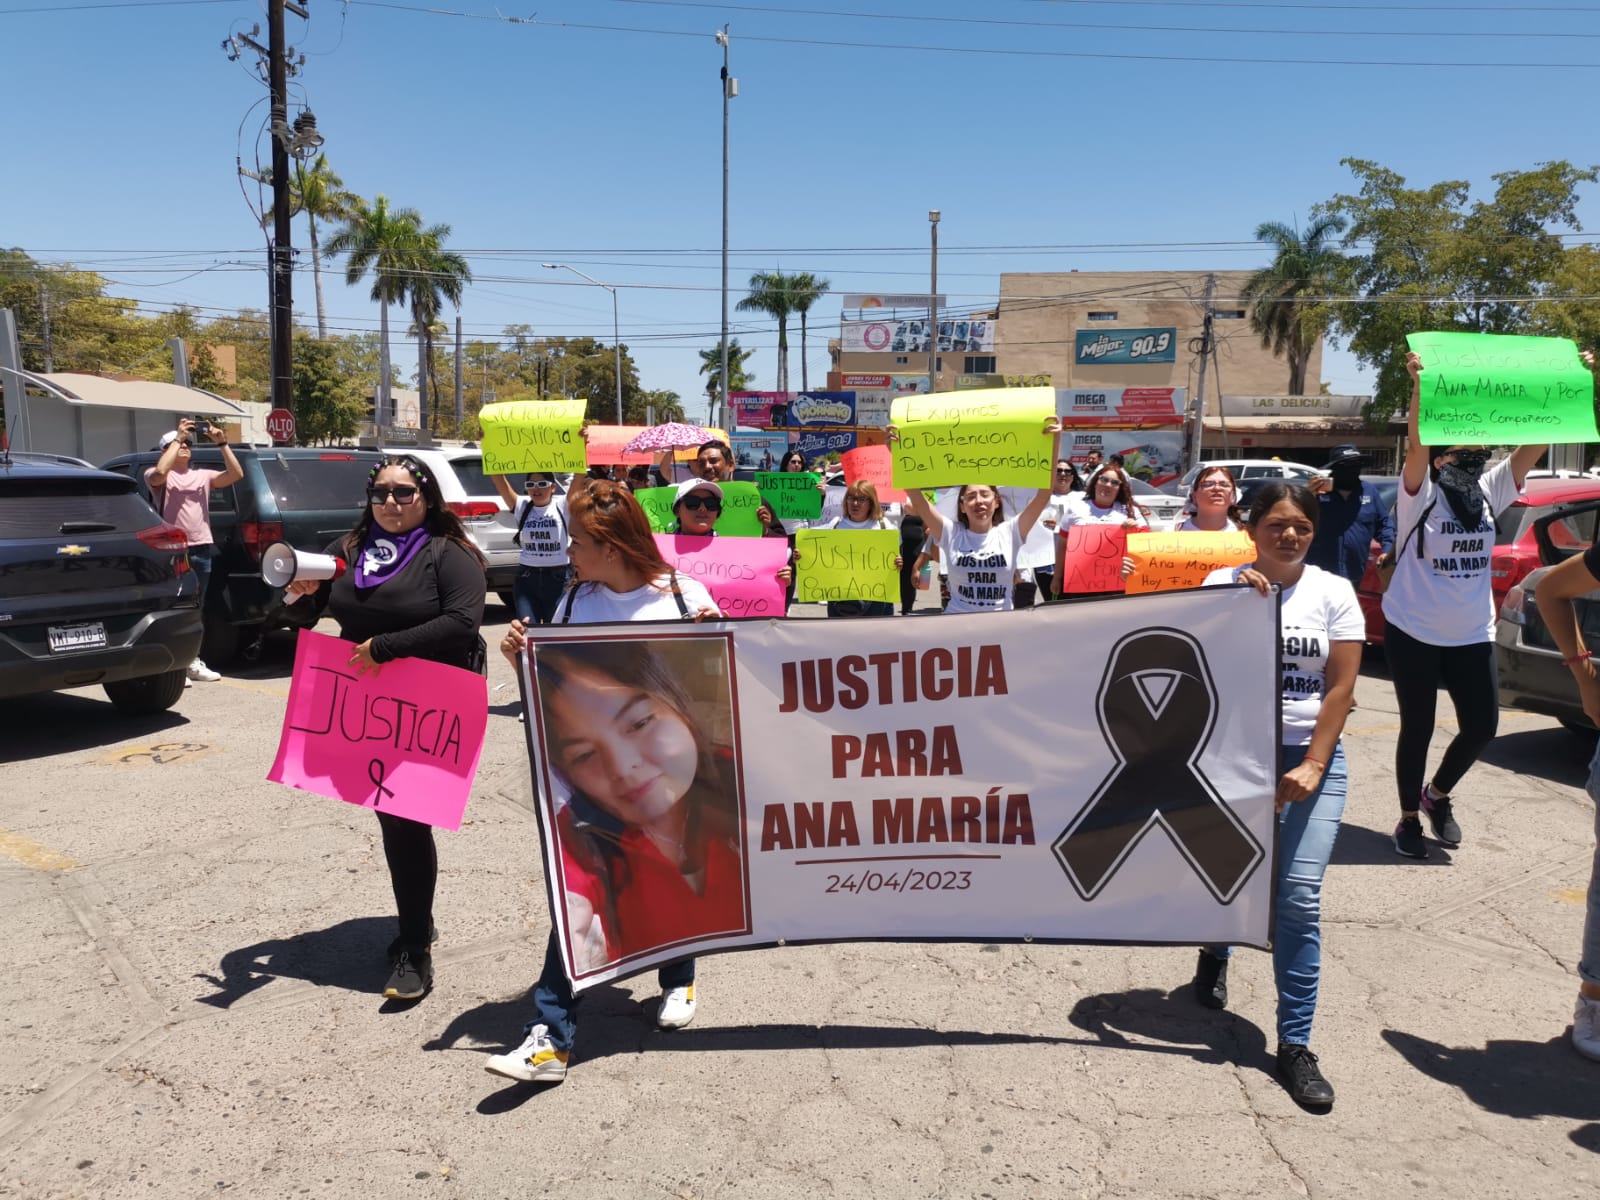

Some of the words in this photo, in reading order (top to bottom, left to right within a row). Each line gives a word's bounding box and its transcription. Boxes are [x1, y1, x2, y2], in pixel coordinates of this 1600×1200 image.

[1080, 340, 1124, 358] Mejor
[1130, 332, 1170, 358] 90.9
[1075, 393, 1106, 405] MEGA
[1252, 398, 1274, 408] LAS
[1280, 398, 1331, 408] DELICIAS
[799, 405, 850, 420] MORNING
[906, 401, 1000, 428] Exigimos
[1424, 408, 1482, 424] Nuestros
[269, 418, 293, 432] ALTO
[828, 433, 852, 449] 90.9
[1075, 435, 1103, 445] MEGA
[484, 452, 517, 472] Para
[901, 456, 934, 472] Del
[944, 451, 1052, 474] Responsable
[759, 474, 817, 490] JUSTICIA
[530, 531, 551, 540] PARA
[1451, 539, 1484, 553] PARA
[956, 554, 1007, 568] JUSTICIA
[1148, 557, 1175, 569] Ana
[1432, 557, 1458, 571] ANA
[967, 571, 997, 584] PARA
[1141, 575, 1162, 590] Hoy
[803, 577, 841, 599] Para
[779, 644, 1009, 713] JUSTICIA
[289, 666, 460, 765] JUSTICIA
[831, 724, 963, 779] PARA
[760, 800, 861, 852] ANA
[872, 786, 1036, 846] MARÍA
[825, 868, 973, 895] 24/04/2023
